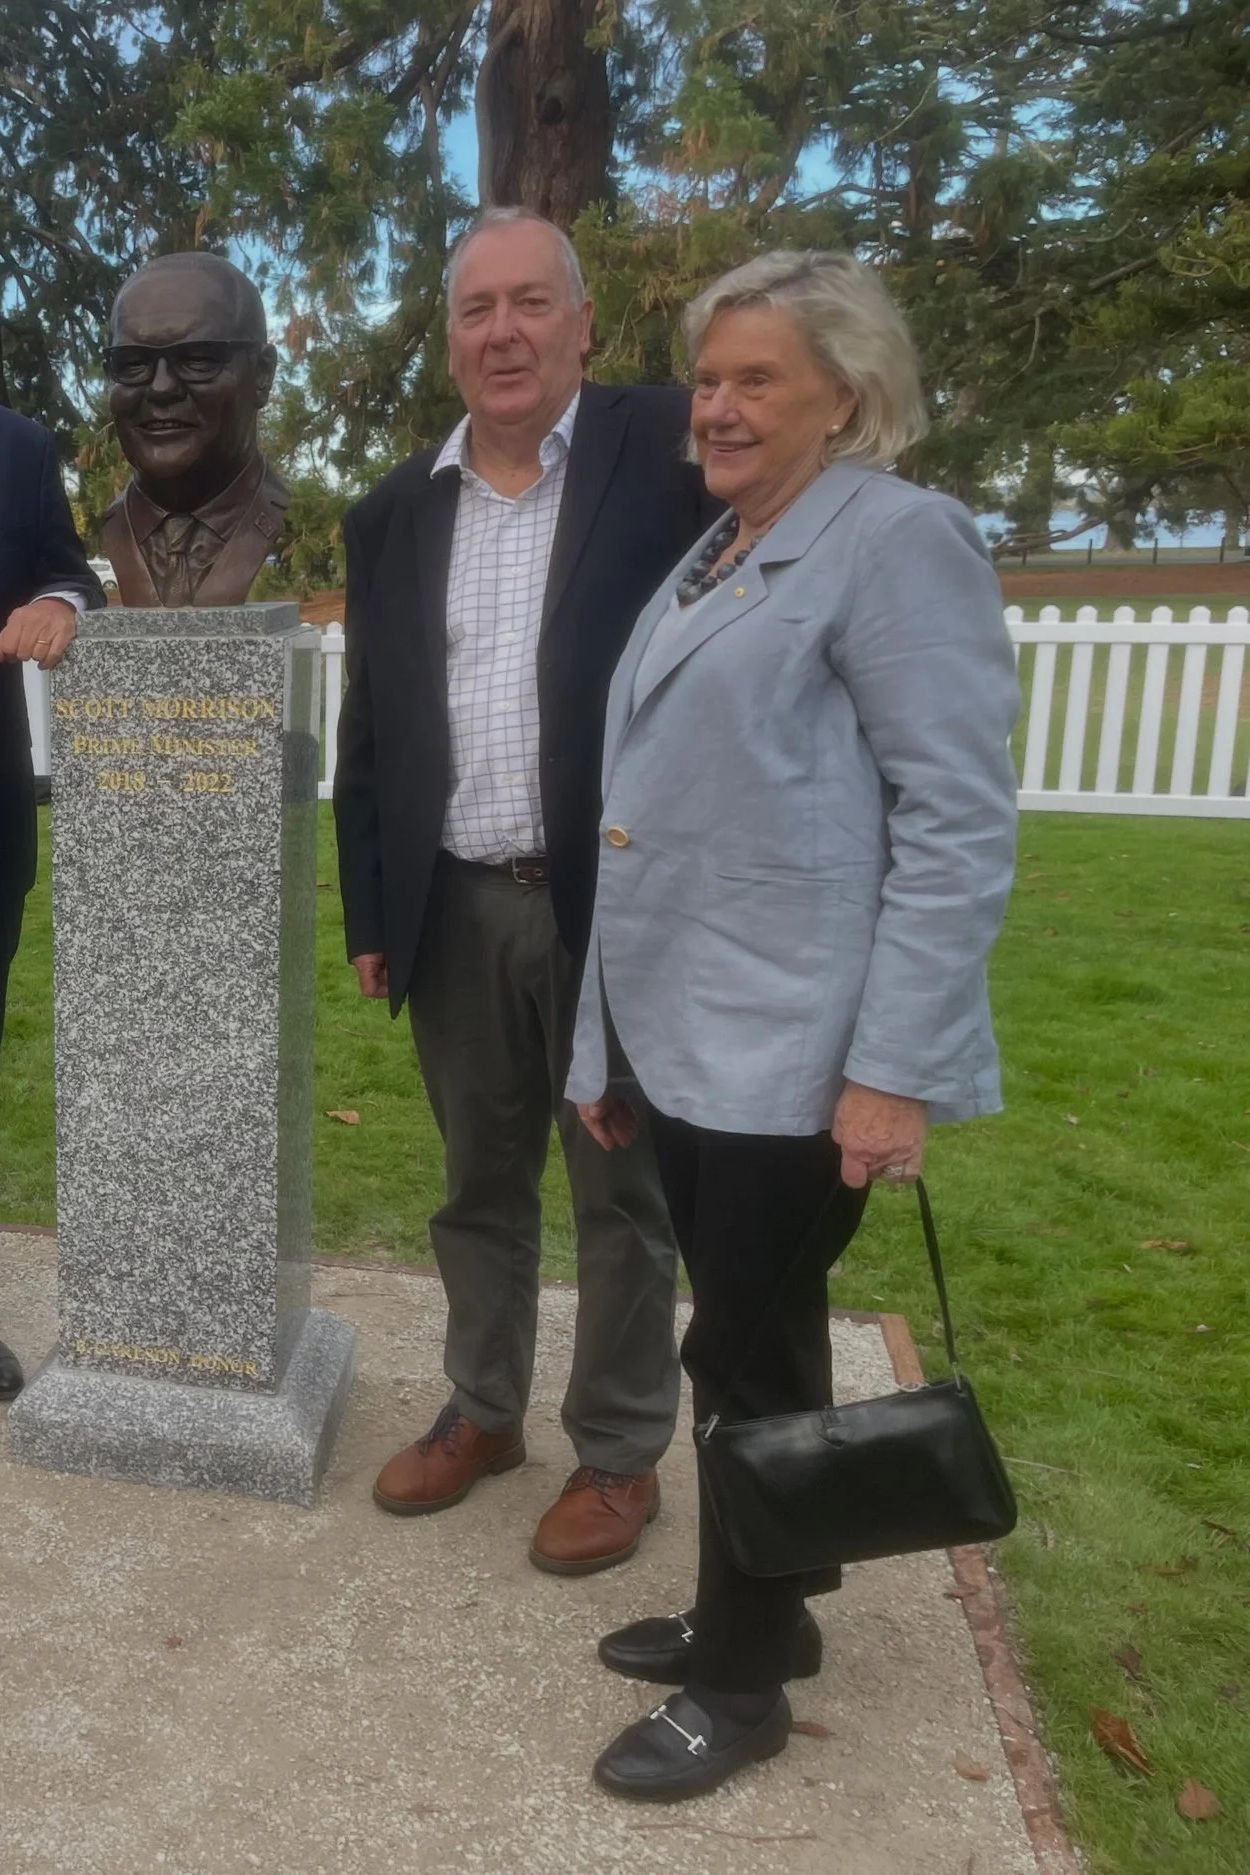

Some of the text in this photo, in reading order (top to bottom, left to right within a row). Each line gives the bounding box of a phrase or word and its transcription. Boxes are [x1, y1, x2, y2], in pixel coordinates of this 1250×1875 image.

[55, 697, 276, 720] SCOTT MORRISON
[72, 734, 260, 757] PRIME MINISTER
[97, 770, 146, 791] 2018
[182, 771, 233, 793] 2022
